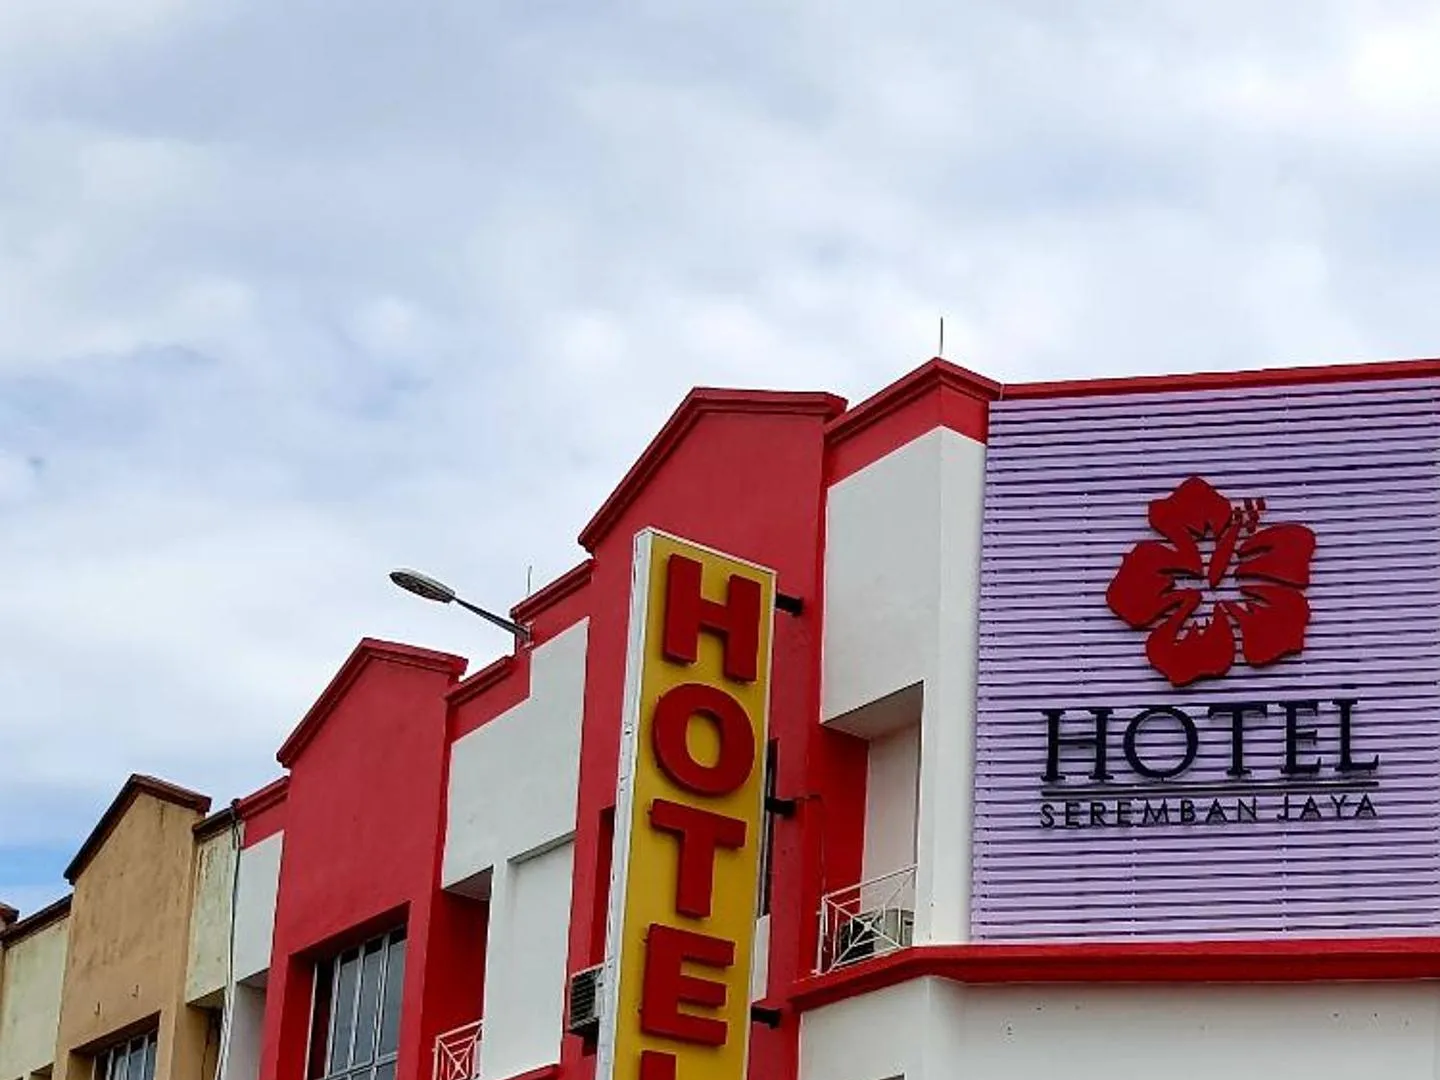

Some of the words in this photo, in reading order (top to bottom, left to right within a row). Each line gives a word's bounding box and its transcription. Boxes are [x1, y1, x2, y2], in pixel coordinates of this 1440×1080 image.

[1041, 699, 1379, 783] HOTEL
[1040, 797, 1258, 829] SEREMBAN
[1276, 794, 1379, 822] JAYA
